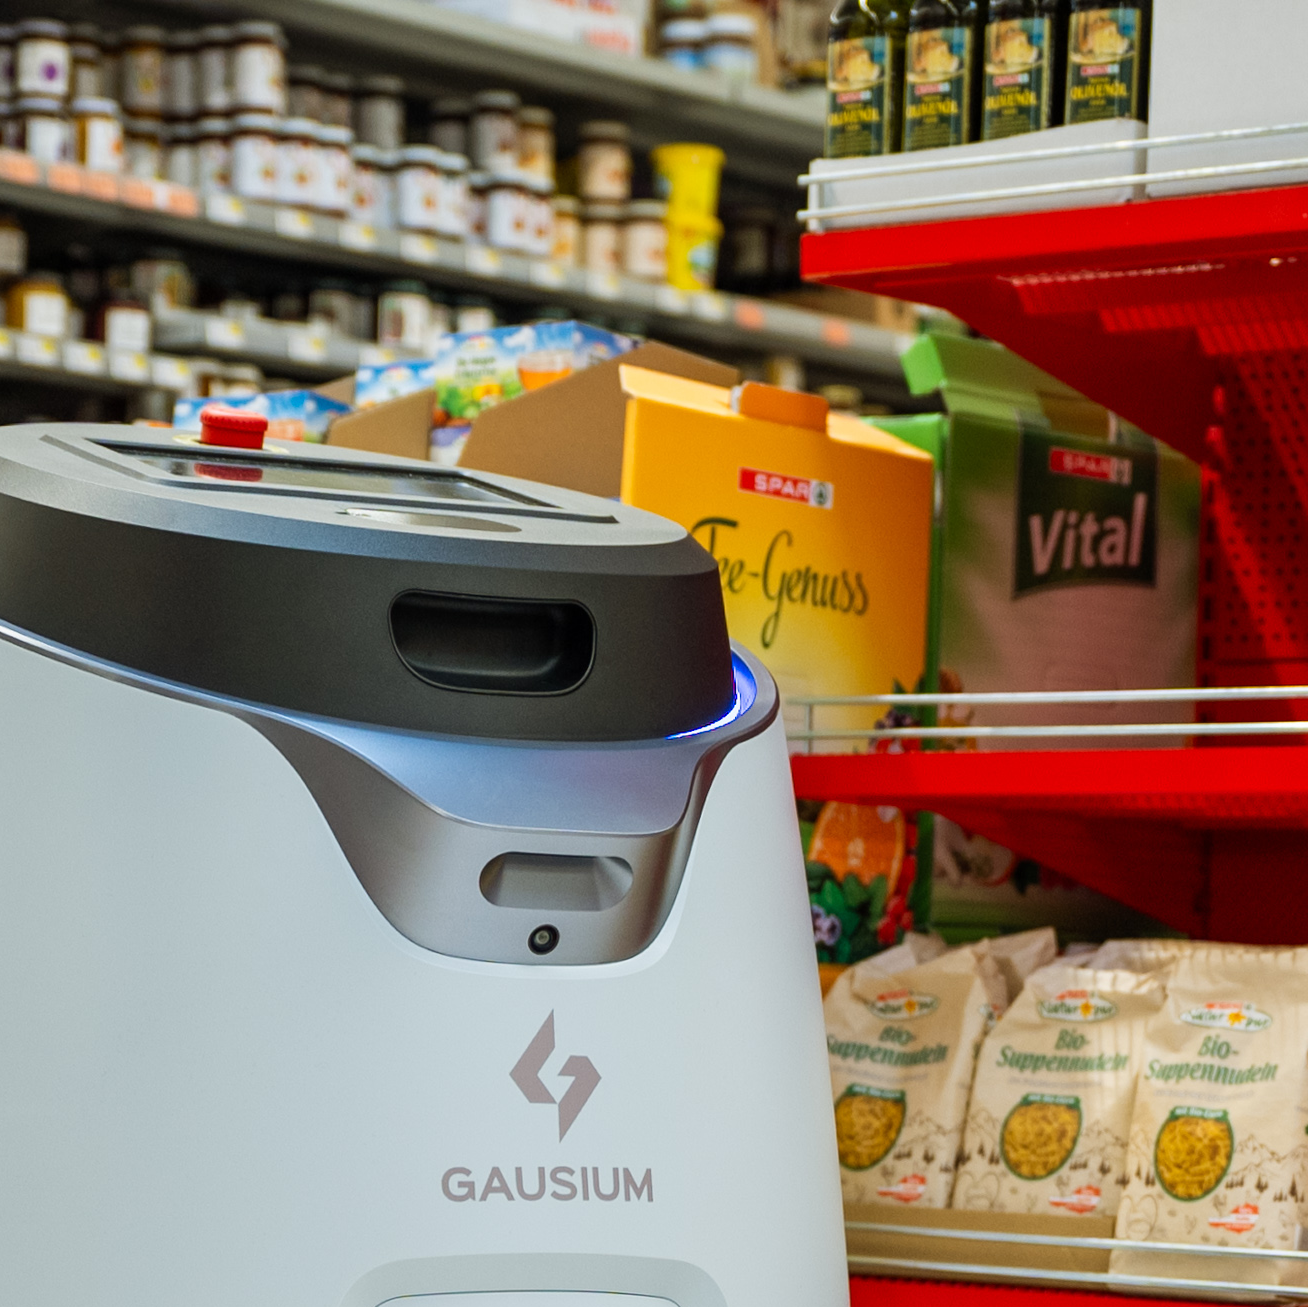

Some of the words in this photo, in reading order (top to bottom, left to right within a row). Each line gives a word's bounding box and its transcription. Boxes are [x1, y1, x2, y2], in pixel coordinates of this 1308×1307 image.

[754, 473, 810, 500] SPAR
[1028, 491, 1149, 576] Vital
[692, 516, 870, 649] Tee-Genuss
[1054, 1028, 1090, 1051] Bio-
[1197, 1033, 1240, 1060] Bio-
[996, 1045, 1130, 1073] Suppennudeln
[1144, 1058, 1279, 1086] Suppennudeln
[441, 1166, 654, 1203] GAUSIUM
